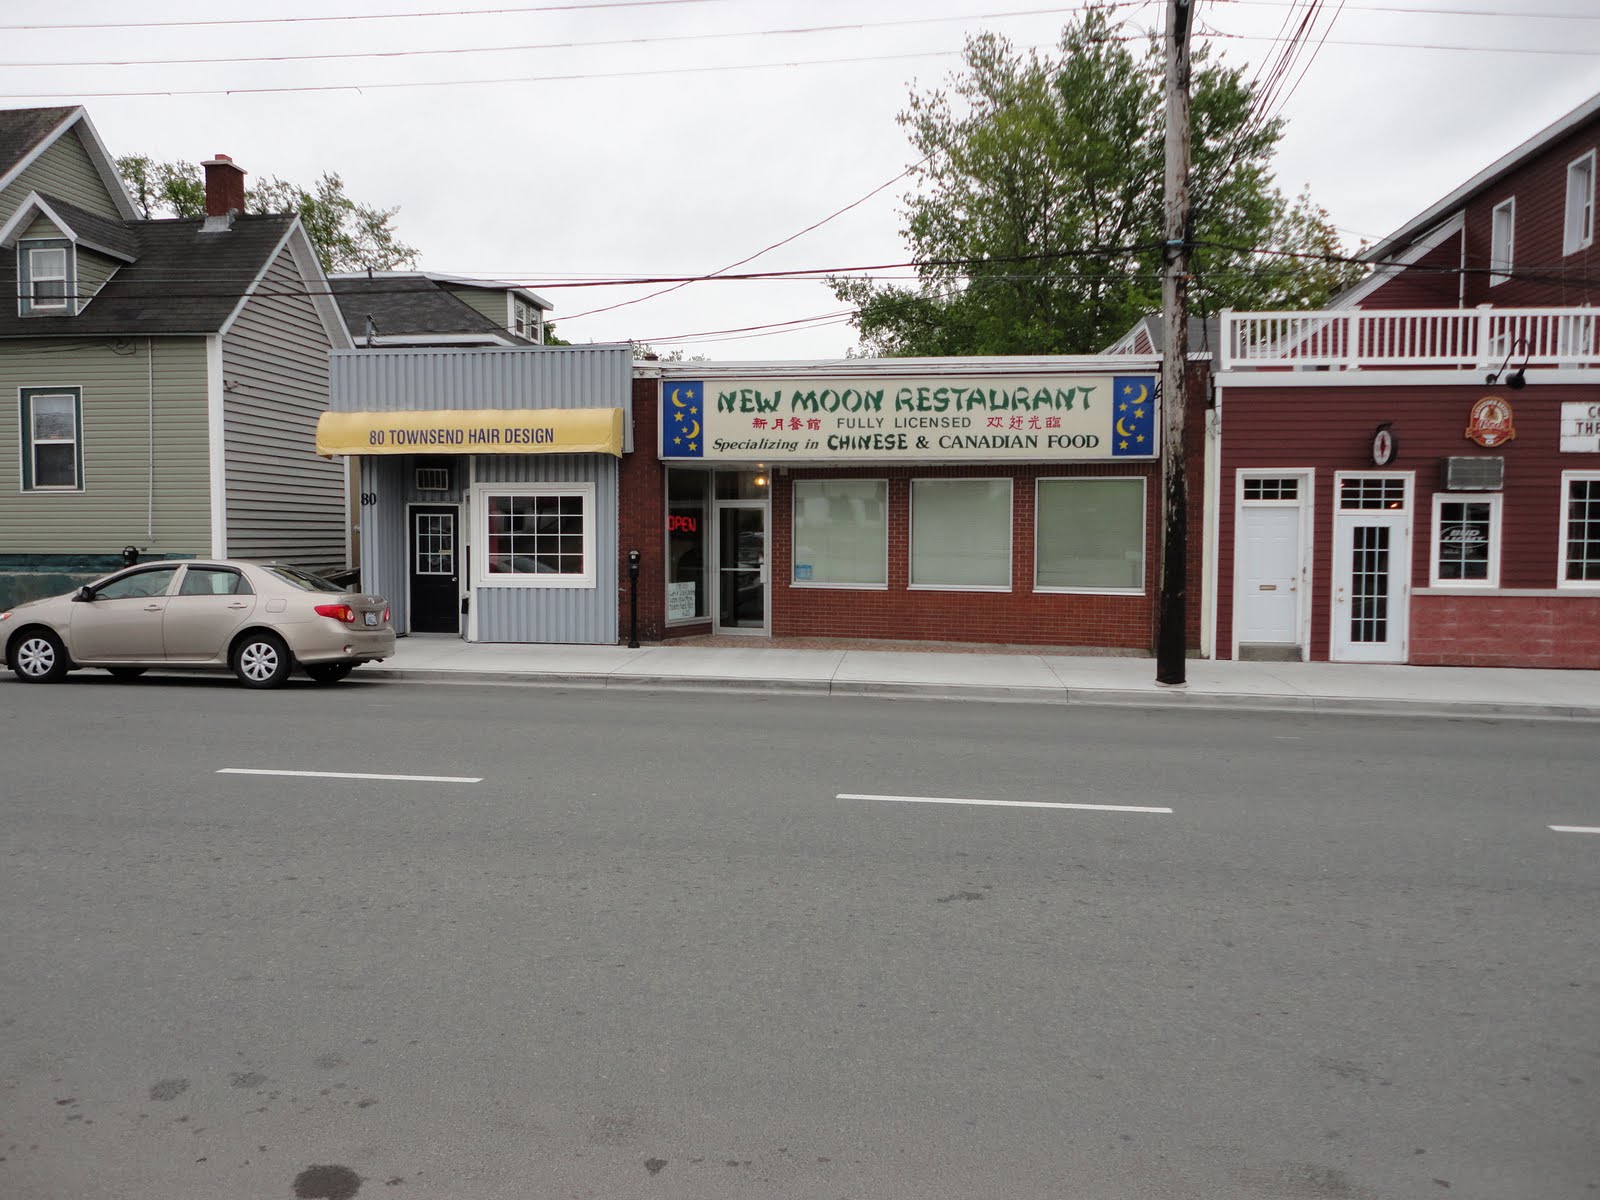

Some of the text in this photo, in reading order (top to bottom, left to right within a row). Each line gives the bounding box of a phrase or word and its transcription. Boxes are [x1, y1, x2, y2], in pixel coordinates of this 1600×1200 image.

[717, 386, 1097, 414] NEW MOON RESTAURANT
[752, 416, 822, 432] 新月餐館
[837, 416, 972, 429] FULLY LICENSED
[369, 427, 554, 446] 80 TOWNSEND HAIR DESIGN
[712, 433, 1100, 453] Specializing in CHINESE & CANADIAN FOOD
[361, 492, 377, 506] 80
[667, 515, 696, 533] OPEN
